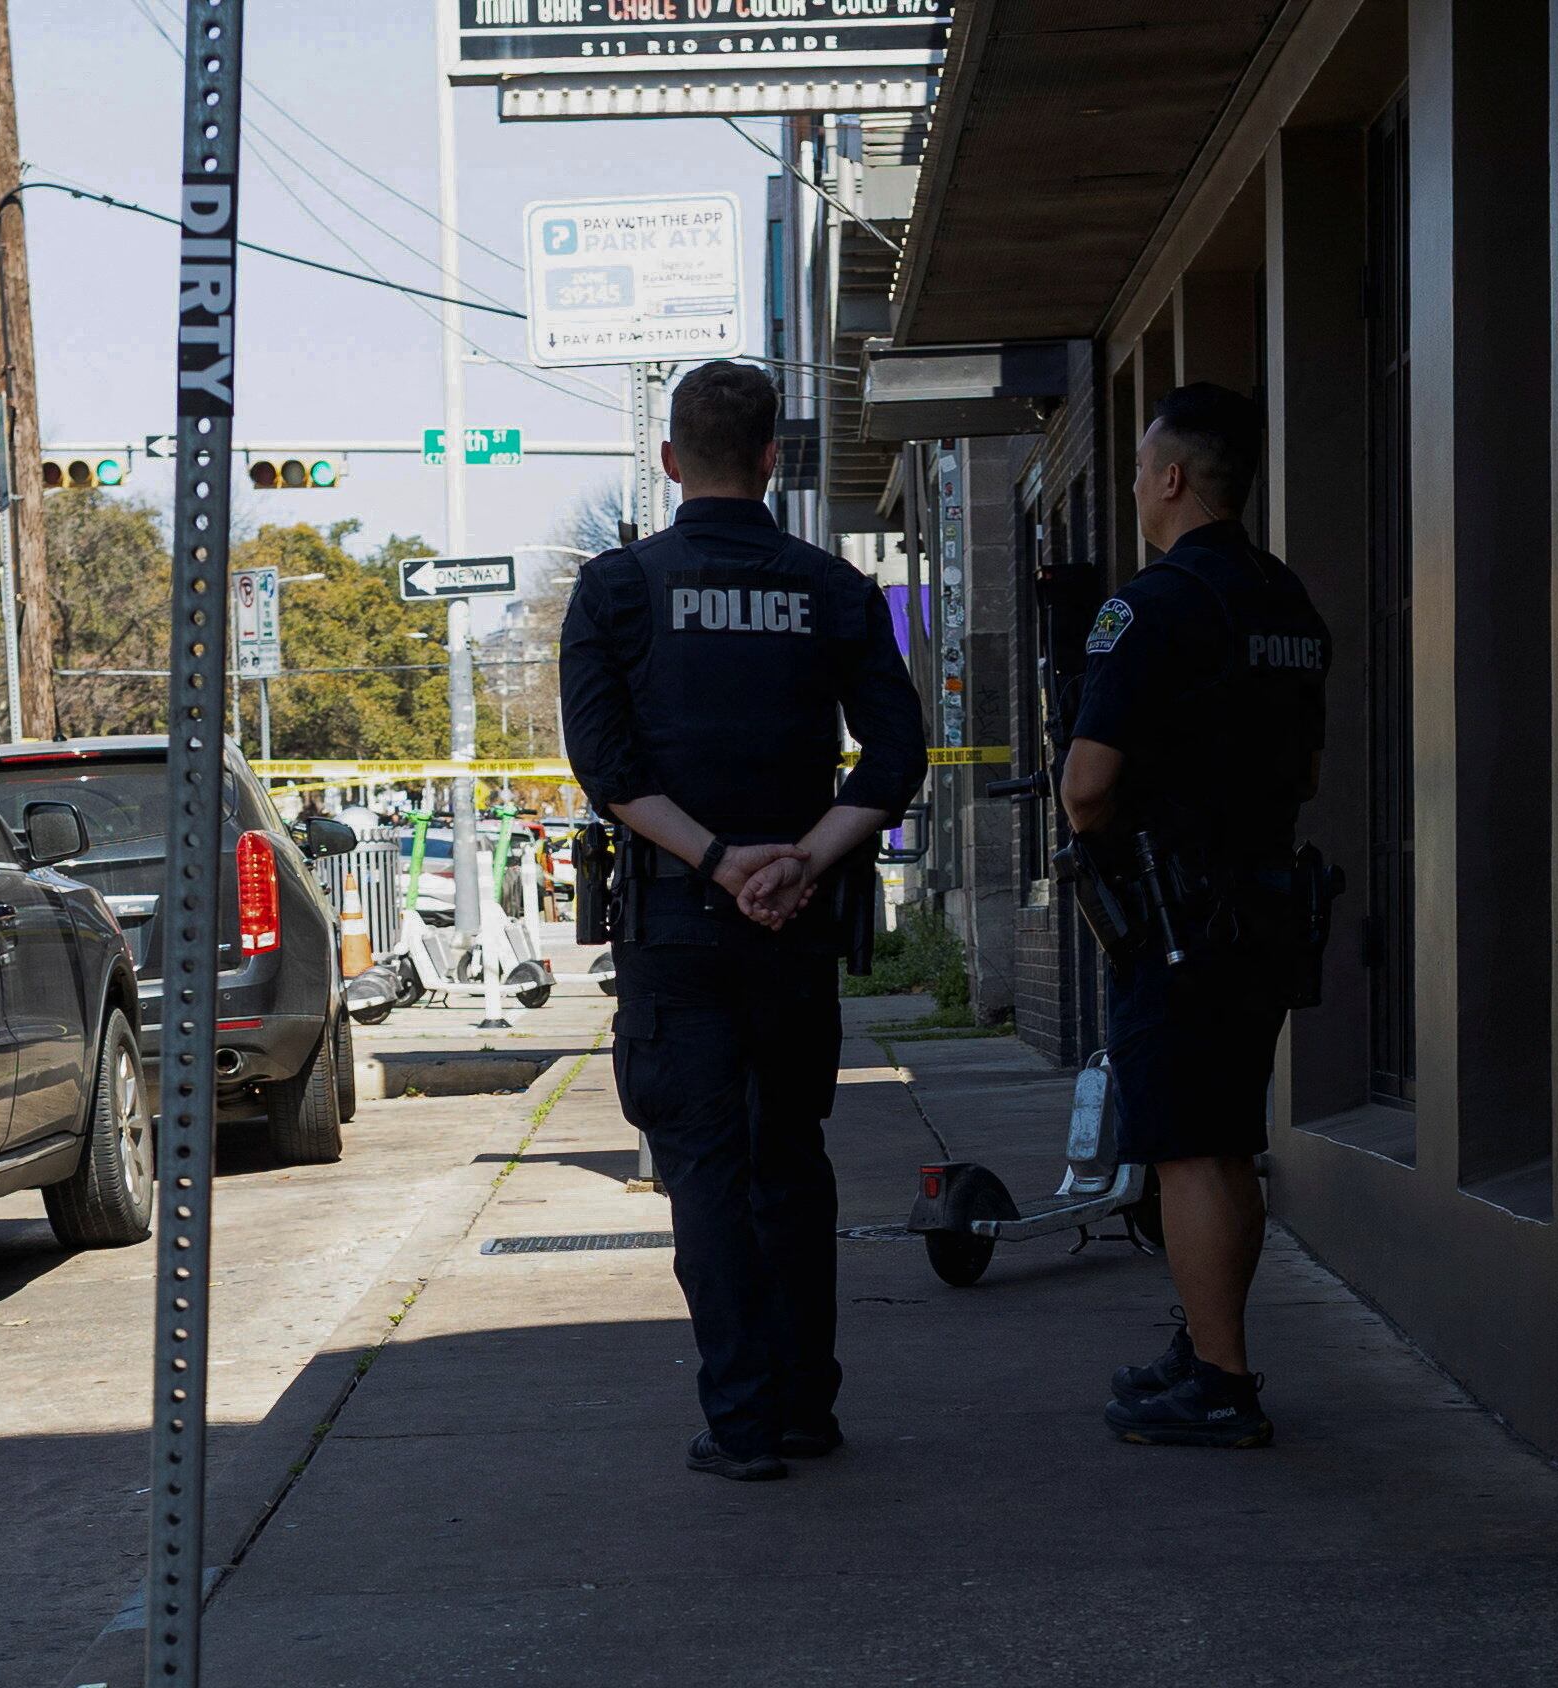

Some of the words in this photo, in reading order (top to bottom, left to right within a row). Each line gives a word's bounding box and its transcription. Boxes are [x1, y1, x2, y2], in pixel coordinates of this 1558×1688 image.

[538, 0, 583, 22] BAR
[608, 0, 678, 21] CABLE
[581, 41, 626, 56] 511
[647, 39, 698, 55] RIO
[718, 35, 838, 53] GRANDE
[583, 218, 611, 230] PAY
[661, 214, 689, 227] THE
[692, 211, 723, 225] APP
[584, 231, 657, 252] PARK
[667, 226, 724, 249] ATX
[179, 184, 232, 404] DIRTY
[563, 335, 591, 345] PAY
[595, 332, 613, 343] AT
[436, 569, 466, 585] ONE
[473, 567, 503, 582] WAY
[672, 588, 812, 634] POLICE
[1249, 634, 1323, 669] POLICE
[1207, 1406, 1237, 1421] HOKA
